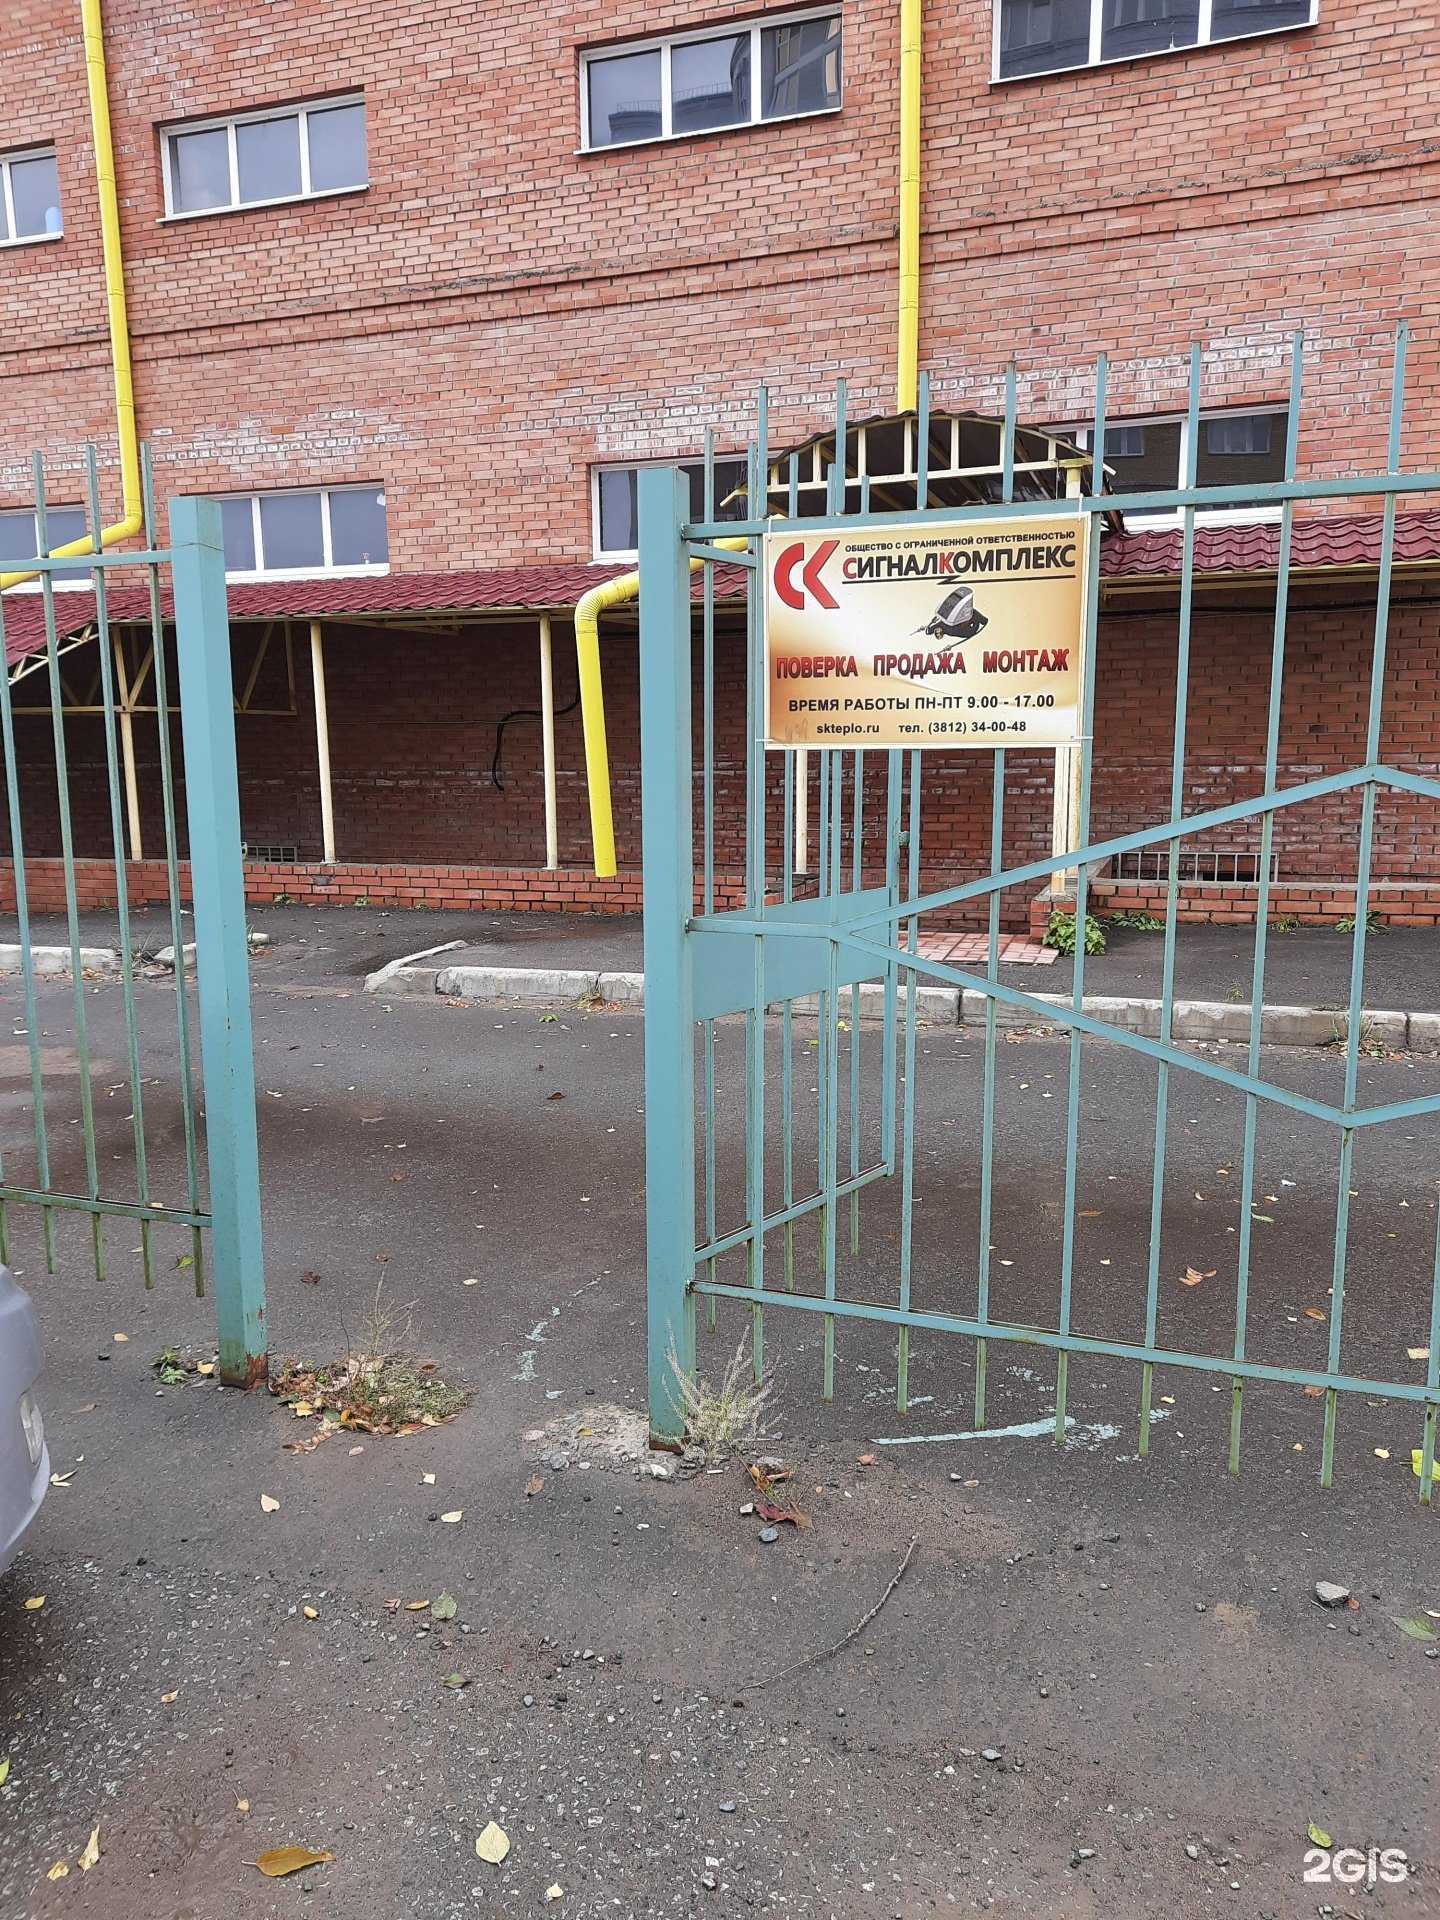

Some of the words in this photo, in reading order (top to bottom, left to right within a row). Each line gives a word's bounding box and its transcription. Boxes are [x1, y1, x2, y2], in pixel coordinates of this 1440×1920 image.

[845, 541, 893, 553] ОБЩЕСТВО
[895, 542, 901, 550] С
[903, 536, 974, 549] ОГРАНИЧЕННОЙ
[976, 531, 1075, 545] ОТВЕТСТВЕННОСТЬЮ
[842, 544, 1076, 579] СИГНАЛКОМПЛЕКС
[776, 655, 859, 679] ПОВЕРКА
[873, 652, 966, 679] ПРОДАЖА
[983, 648, 1070, 673] МОНТАЖ
[789, 699, 839, 712] ВРЕМЯ
[844, 698, 909, 711] РАБОТЫ
[915, 697, 963, 709] ПН-ПТ
[967, 695, 998, 708] 9.00
[1014, 695, 1055, 708] 17.00
[816, 723, 880, 736] skteplo.ru
[898, 724, 924, 733] тел.
[928, 721, 967, 735] (3812)
[971, 721, 1027, 733] 34-00-48
